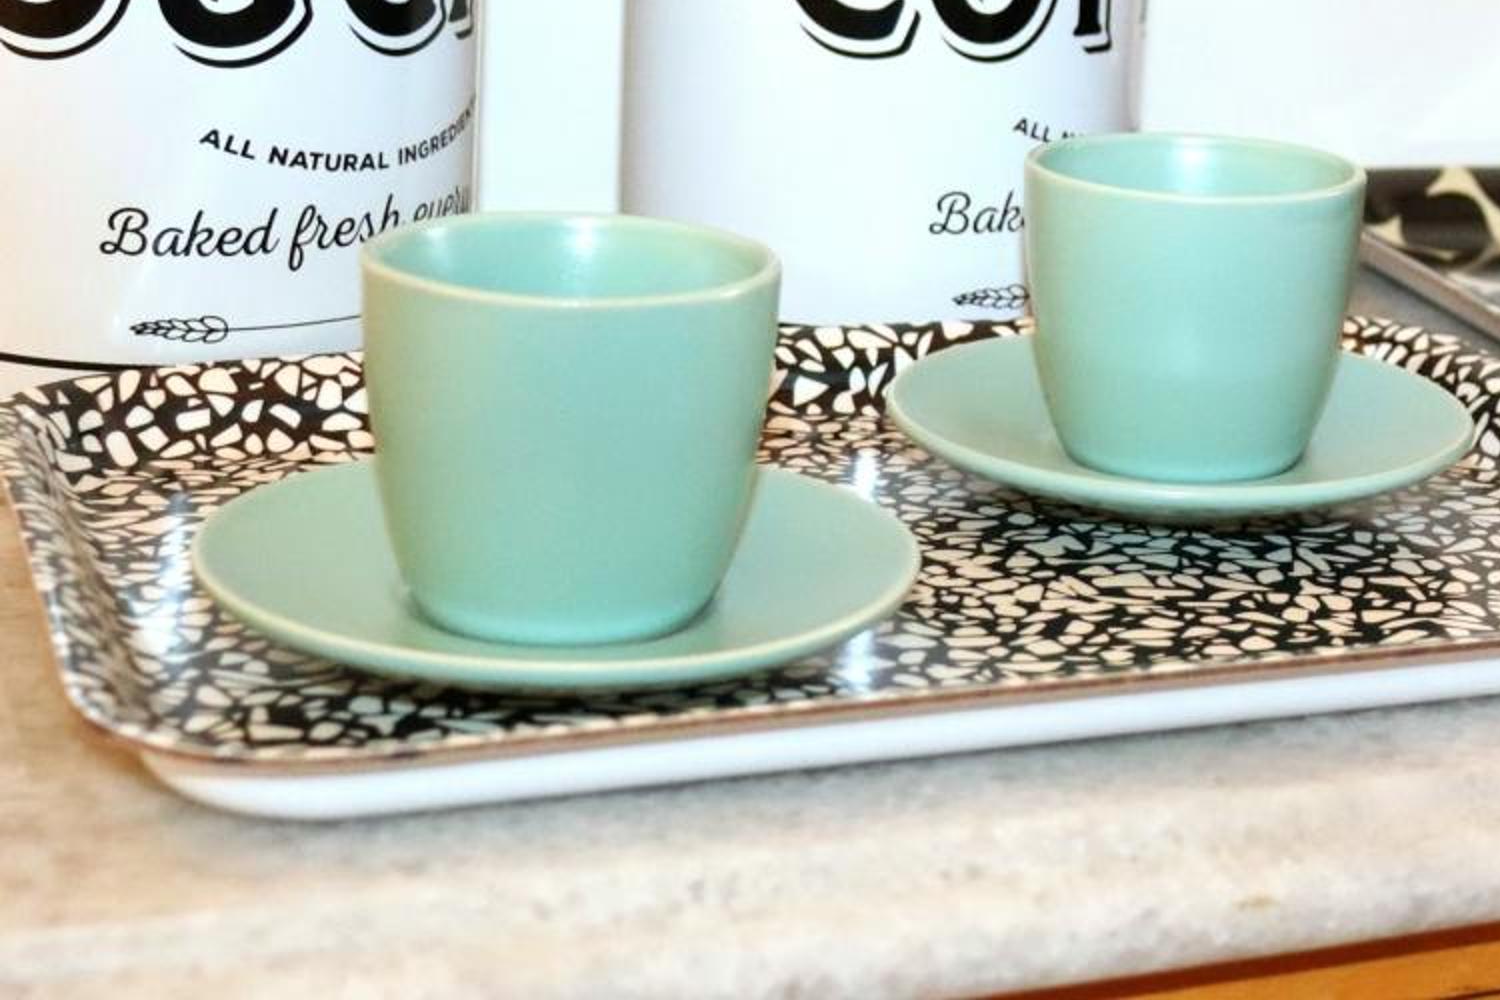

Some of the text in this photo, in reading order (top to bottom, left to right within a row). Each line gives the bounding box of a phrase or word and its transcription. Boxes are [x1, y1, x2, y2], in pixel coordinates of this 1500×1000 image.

[199, 129, 255, 160] ALL
[268, 146, 390, 171] NATURAL
[1013, 117, 1051, 143] ALL
[99, 206, 281, 258] Baked
[288, 193, 399, 272] fresh
[928, 187, 1025, 235] Bak
